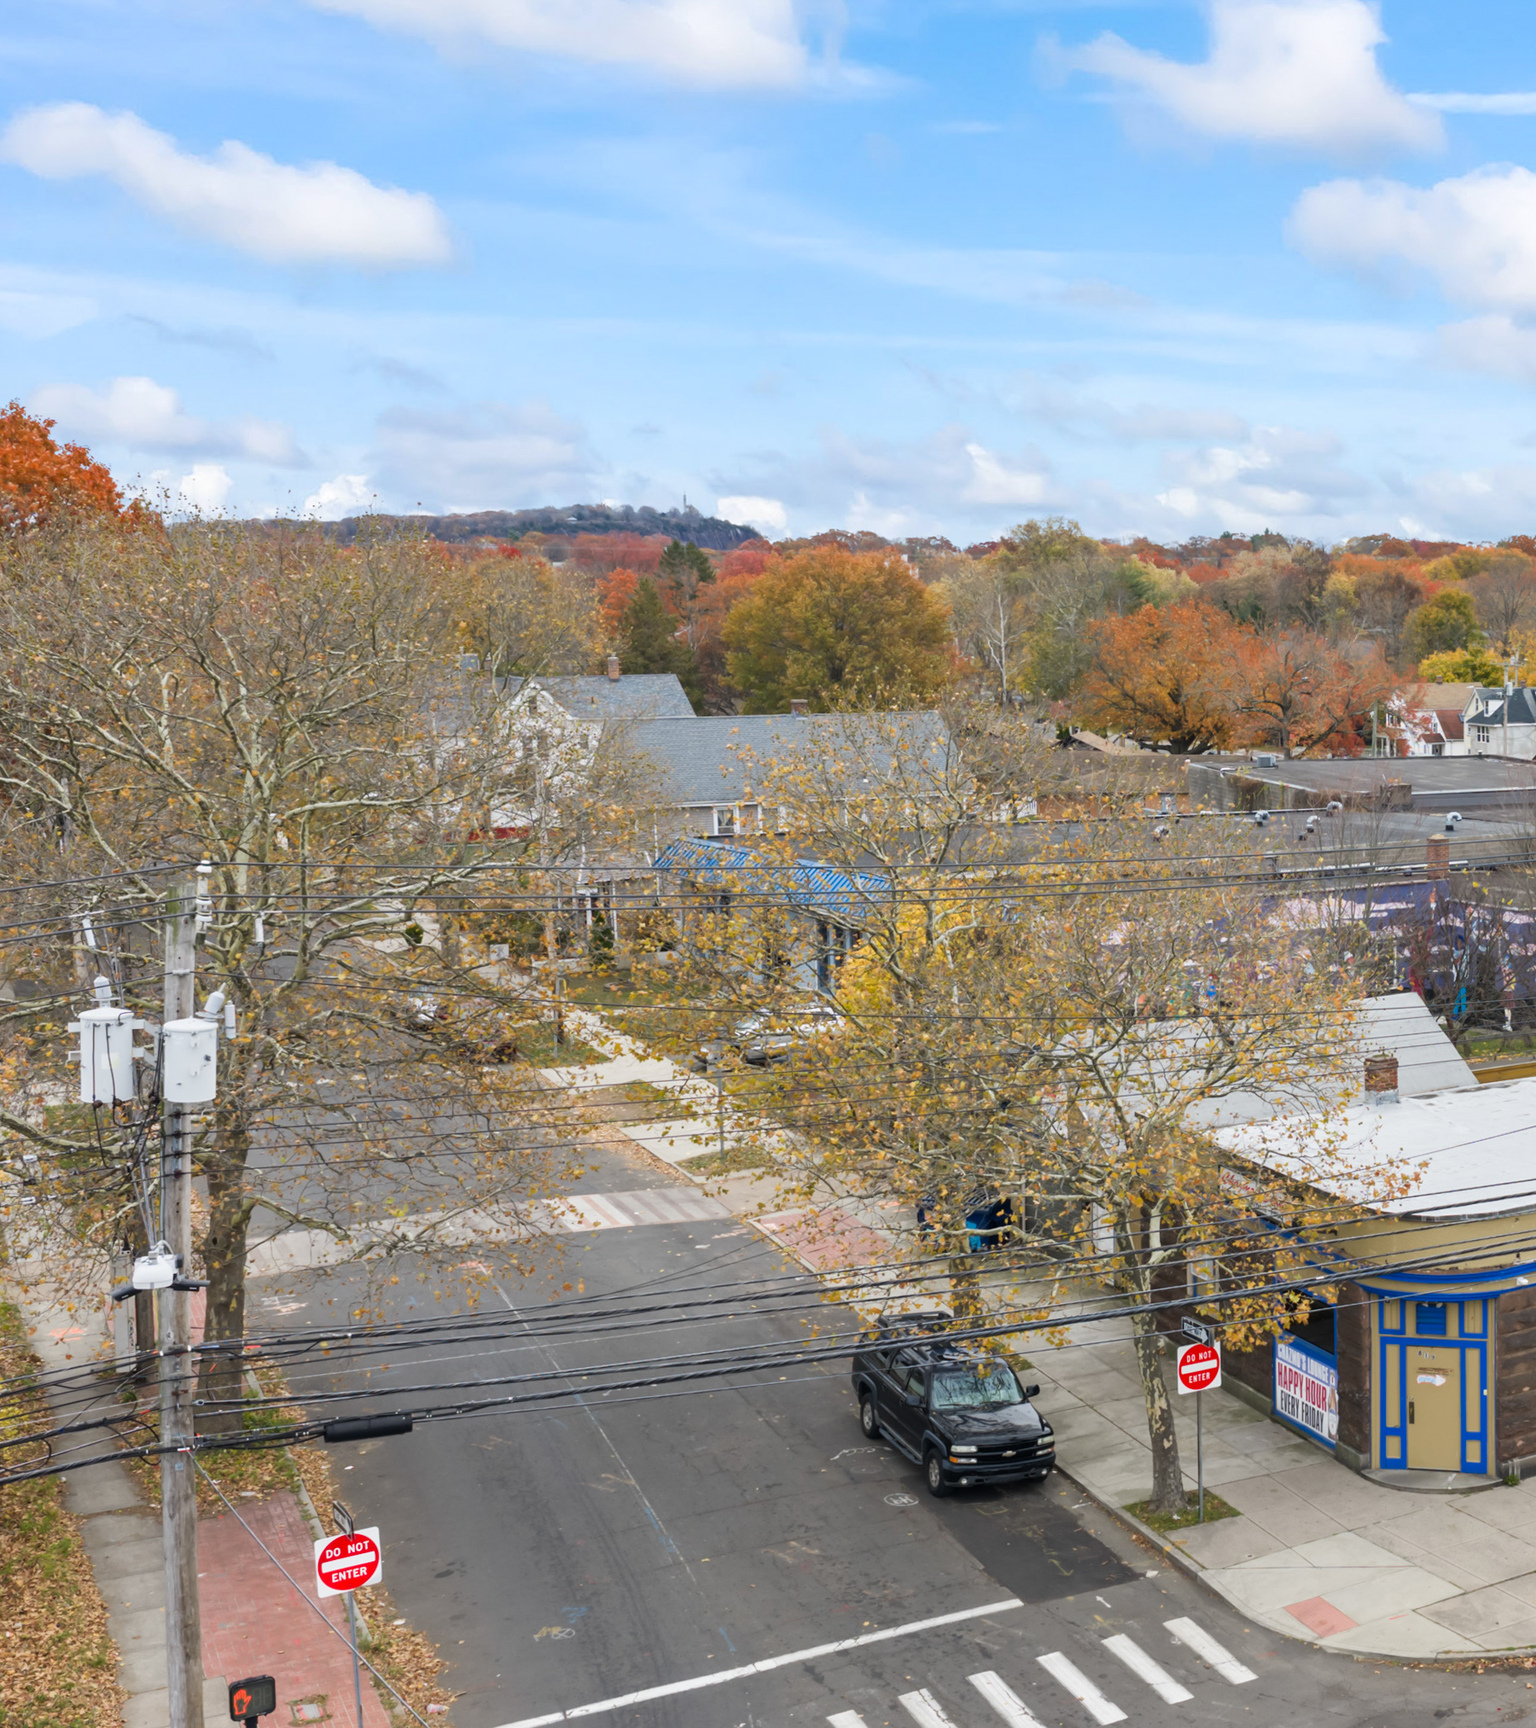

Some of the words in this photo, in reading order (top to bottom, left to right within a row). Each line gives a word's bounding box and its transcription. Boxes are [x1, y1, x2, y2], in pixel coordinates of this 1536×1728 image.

[1186, 1354, 1196, 1363] DO
[1199, 1350, 1212, 1360] NOT
[1188, 1372, 1211, 1383] ENTER
[1278, 1362, 1304, 1398] HAPPY
[1305, 1376, 1327, 1412] HOUR
[1281, 1390, 1300, 1419] EVERY
[1301, 1401, 1324, 1433] FRIDAY
[325, 1547, 341, 1559] DO
[347, 1540, 369, 1554] NOT
[331, 1566, 368, 1583] ENTER
